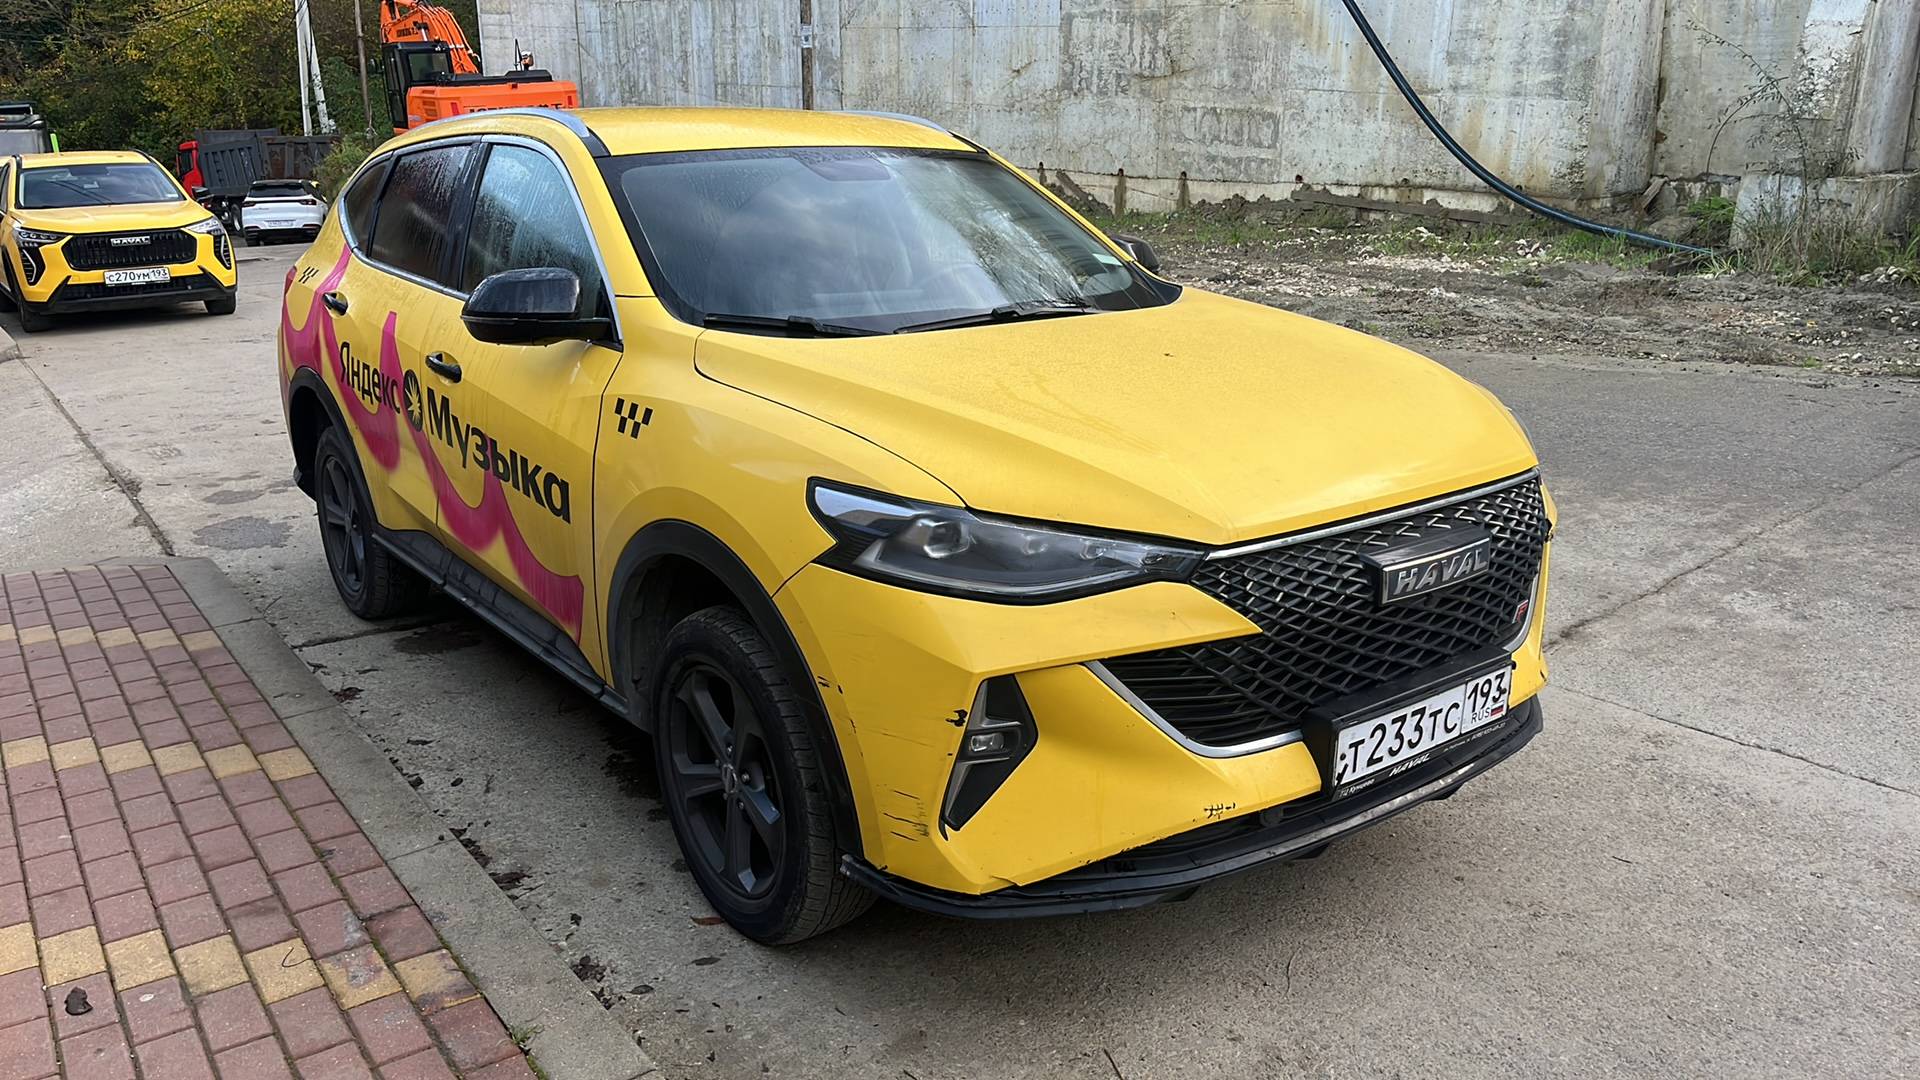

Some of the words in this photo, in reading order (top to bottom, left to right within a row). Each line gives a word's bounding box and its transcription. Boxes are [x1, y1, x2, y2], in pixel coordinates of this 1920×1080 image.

[112, 236, 150, 246] HAVAL
[108, 271, 150, 283] С270УМ
[151, 269, 168, 277] 193
[340, 341, 400, 414] Яндекс
[427, 387, 571, 525] Музыка
[1393, 548, 1488, 596] HAVAL
[1348, 702, 1461, 774] Т233ТС
[1467, 671, 1507, 713] 193
[1470, 706, 1491, 724] RUS
[1389, 753, 1431, 777] HAVAL
